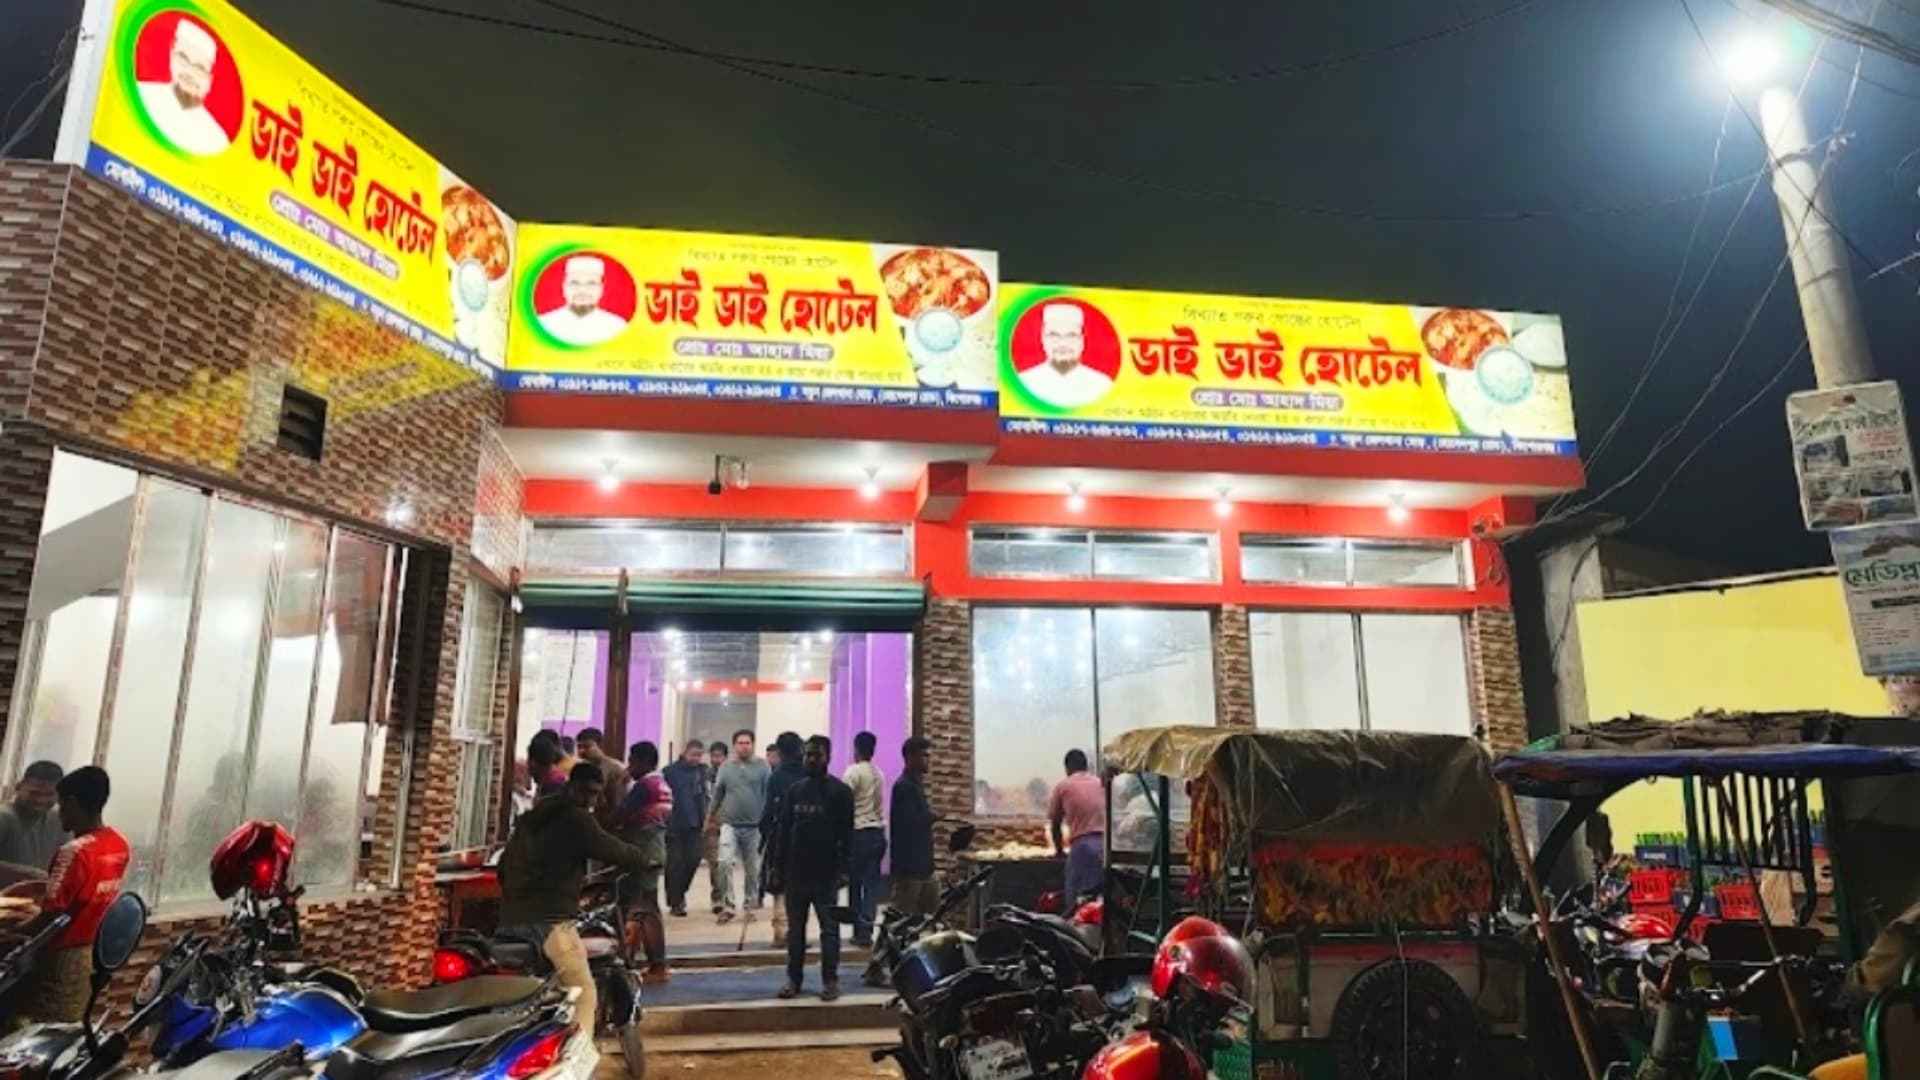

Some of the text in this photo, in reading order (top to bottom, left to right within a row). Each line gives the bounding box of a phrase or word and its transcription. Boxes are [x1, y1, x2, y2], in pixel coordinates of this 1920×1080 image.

[251, 98, 304, 185] ভাই
[312, 140, 358, 219] ভাই
[364, 179, 438, 268] হোটেল
[645, 268, 879, 335] ভাই ভাই হোটেল
[1129, 325, 1423, 389] ভাই ভাই হোটেল
